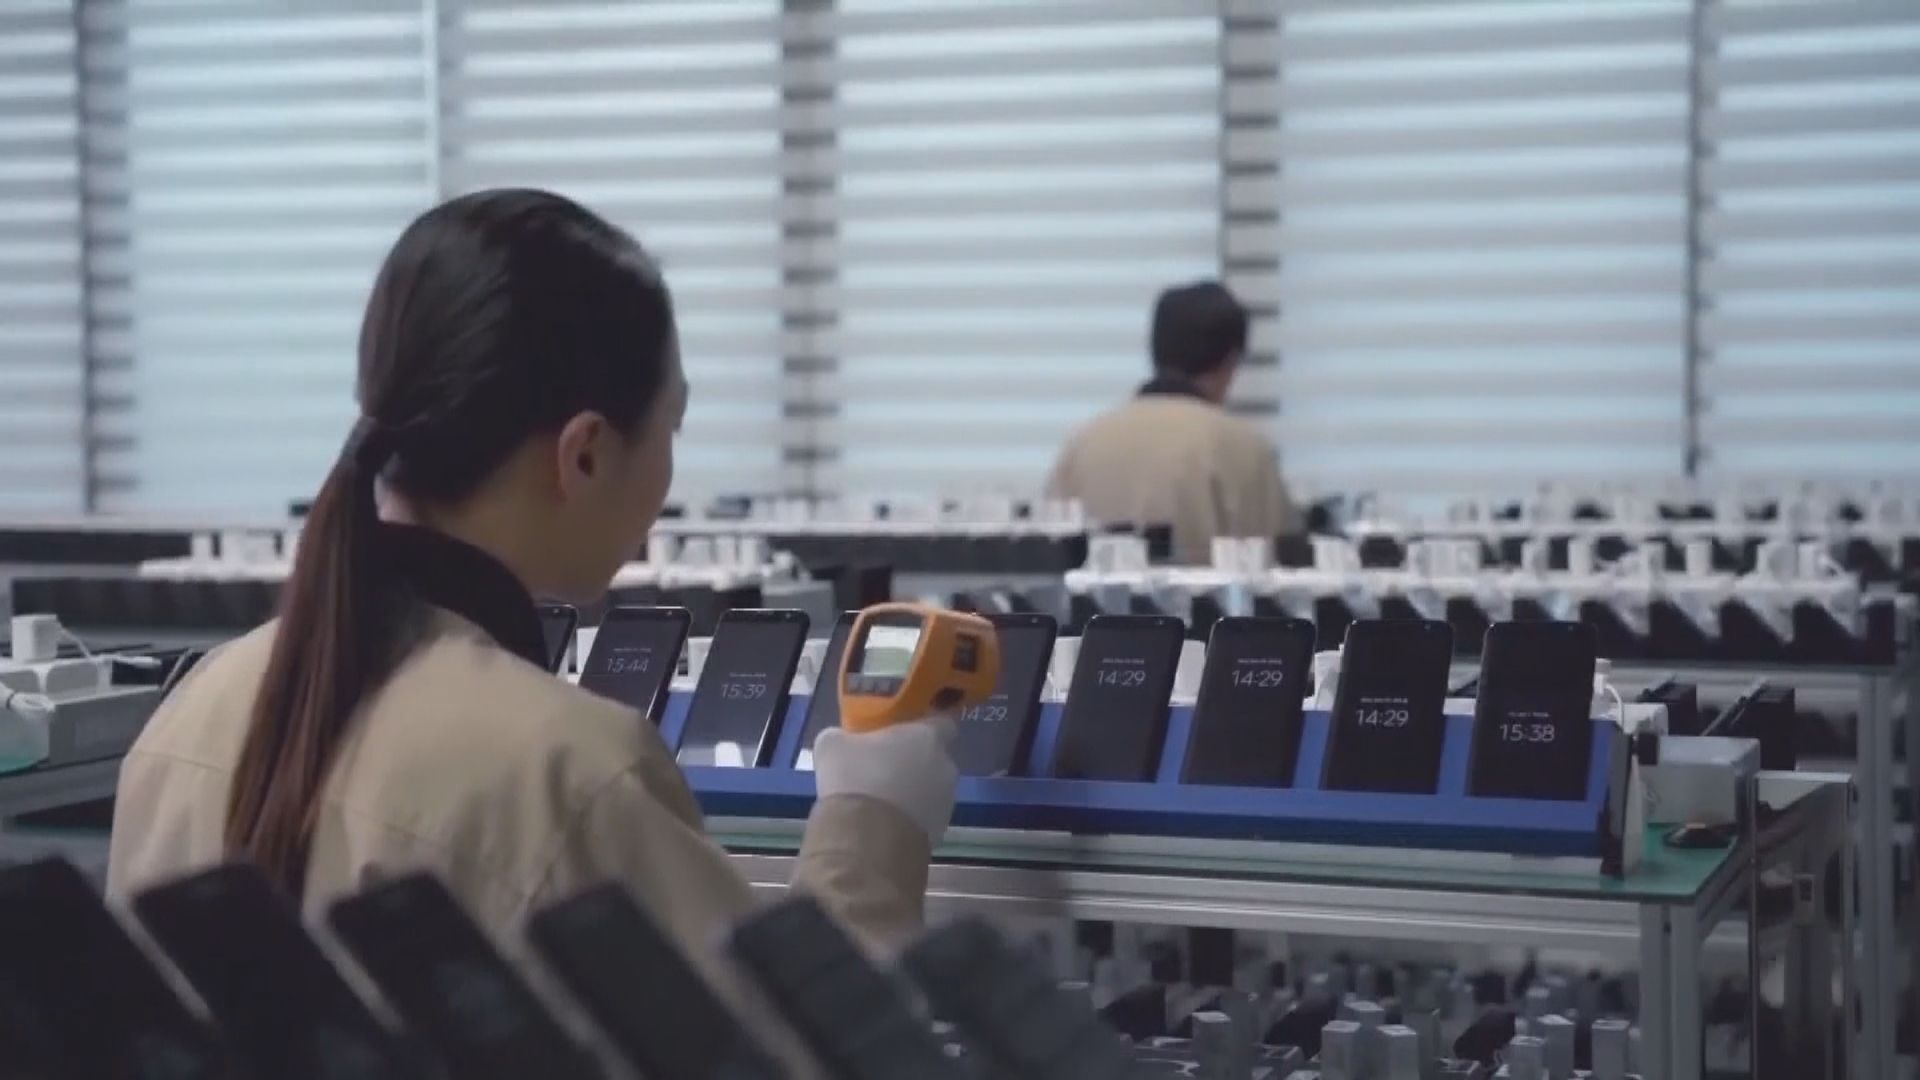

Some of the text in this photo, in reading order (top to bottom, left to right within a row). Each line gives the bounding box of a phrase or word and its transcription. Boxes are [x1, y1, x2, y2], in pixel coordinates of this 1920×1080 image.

[607, 657, 649, 673] 1544
[1231, 669, 1283, 688] 14:29
[721, 683, 767, 700] 1539
[960, 704, 1008, 721] 1429
[1355, 709, 1409, 728] 14:29
[1499, 723, 1555, 743] 15:38
